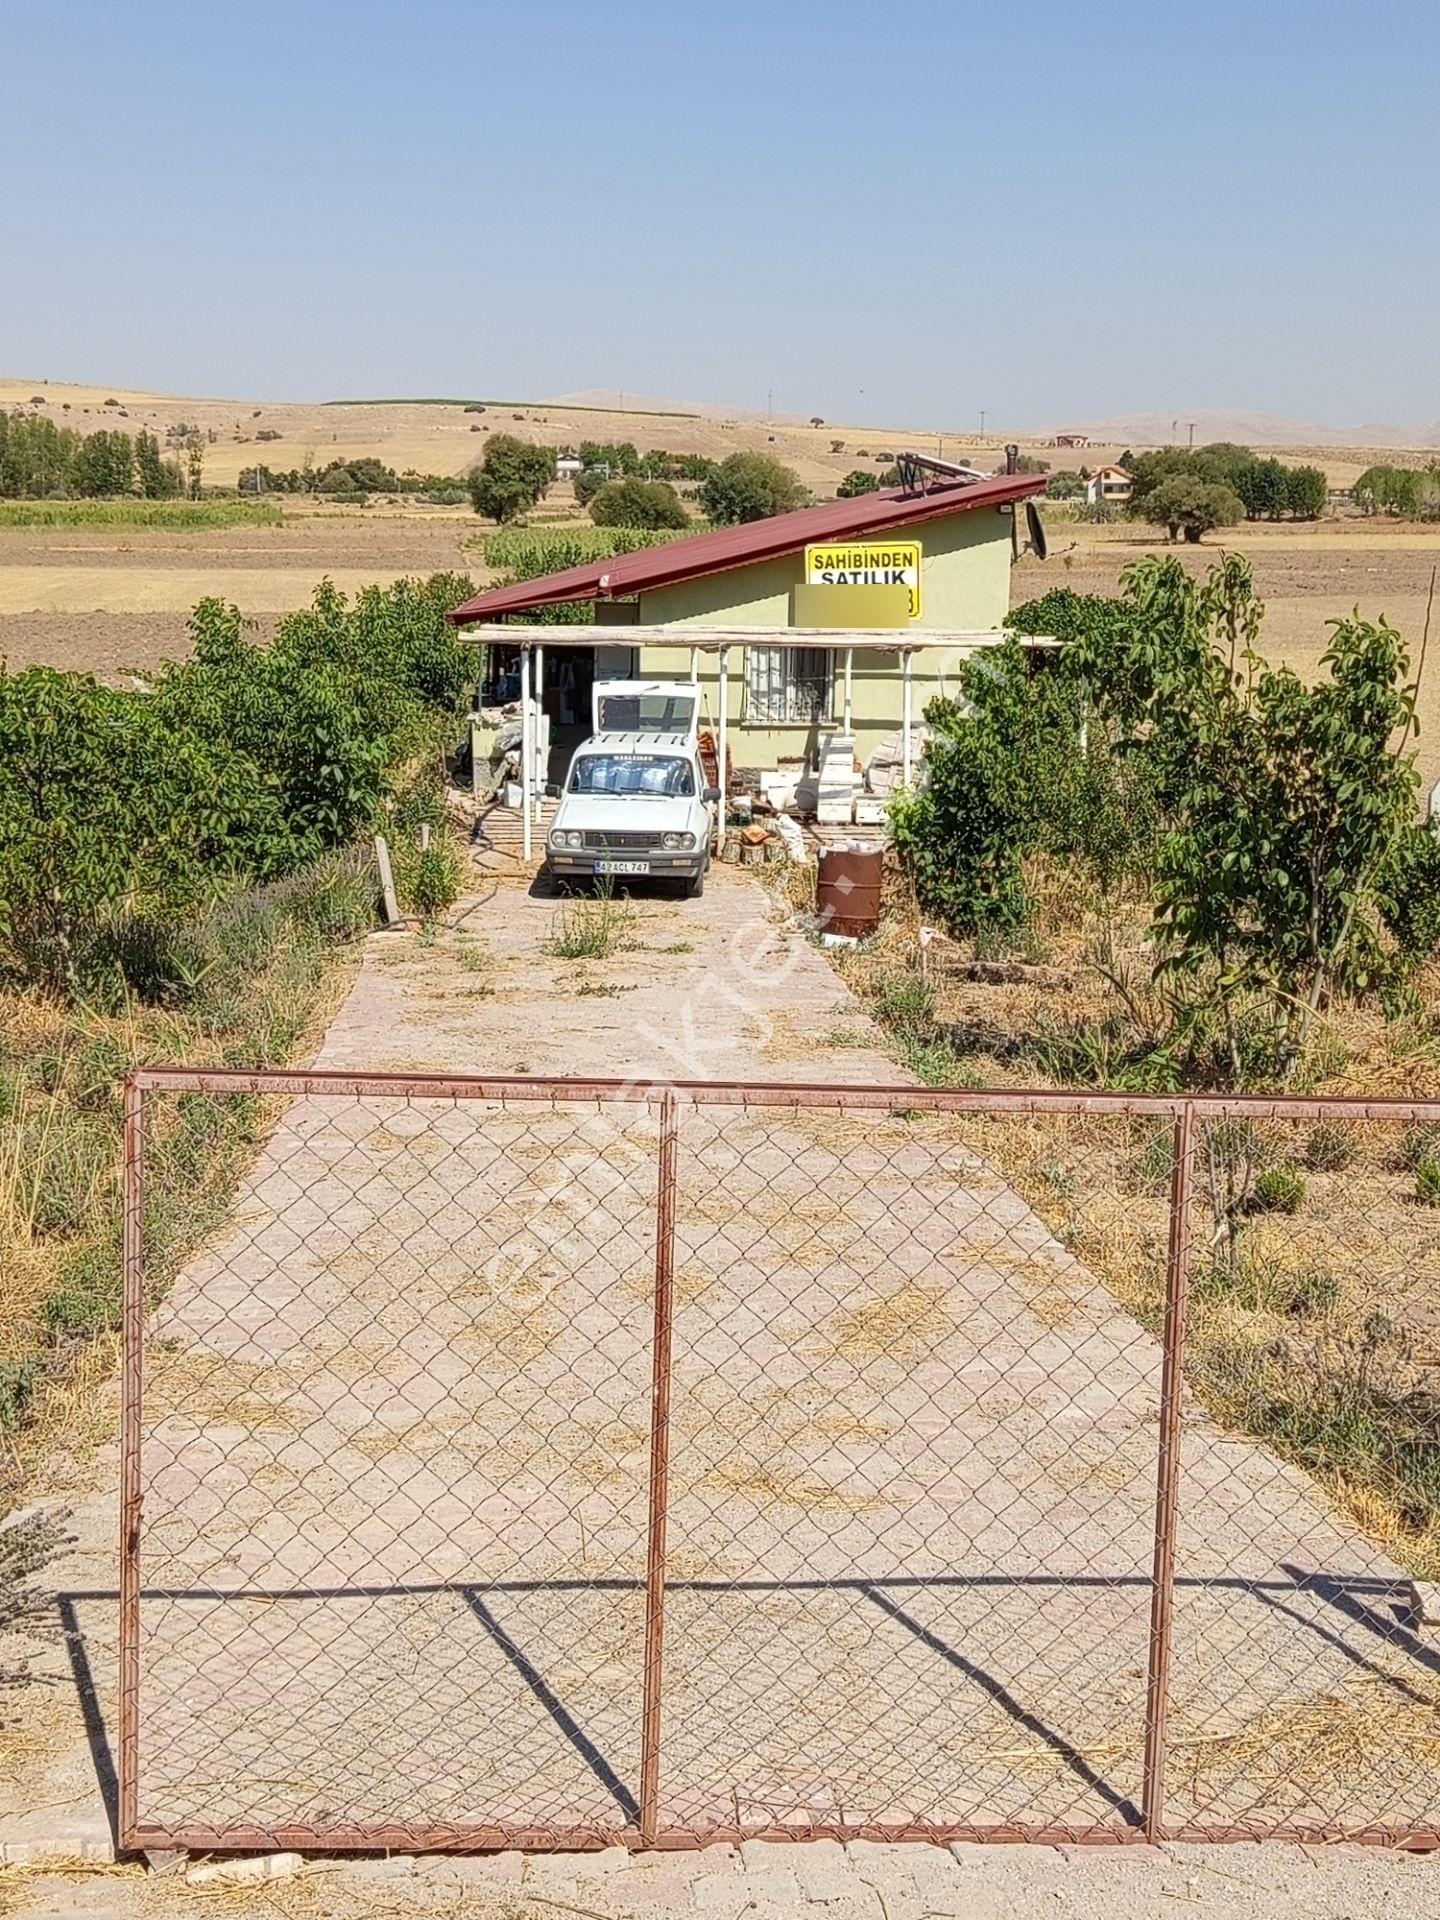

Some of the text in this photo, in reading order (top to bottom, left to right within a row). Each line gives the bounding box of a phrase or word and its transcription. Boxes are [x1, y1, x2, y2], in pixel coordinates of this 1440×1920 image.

[814, 550, 913, 569] SAHİBİNDEN
[821, 570, 906, 585] SATILIK
[601, 862, 647, 873] 42 ACL 747
